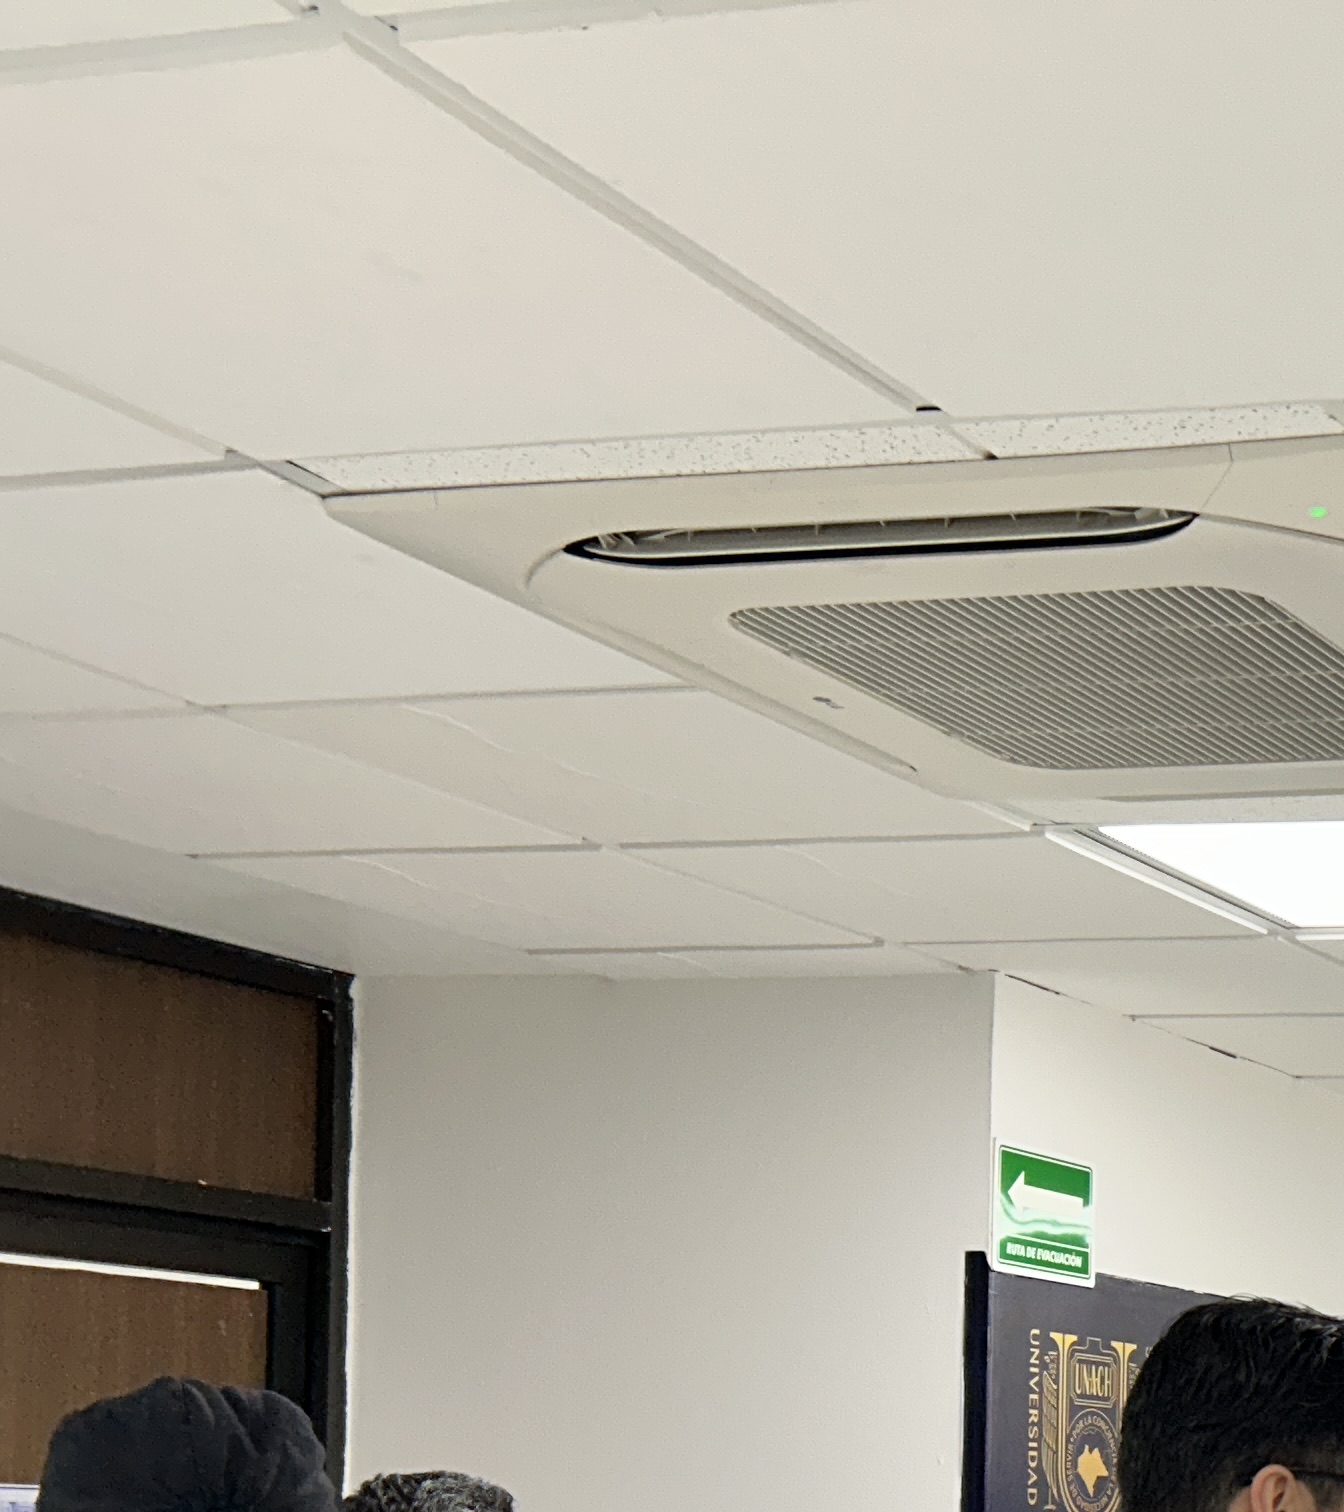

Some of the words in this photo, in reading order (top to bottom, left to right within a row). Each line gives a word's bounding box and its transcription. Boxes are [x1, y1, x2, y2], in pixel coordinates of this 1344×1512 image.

[1006, 1242, 1025, 1257] RUTA
[1026, 1246, 1036, 1259] DE
[1026, 1328, 1041, 1506] UNIVERSIDAD
